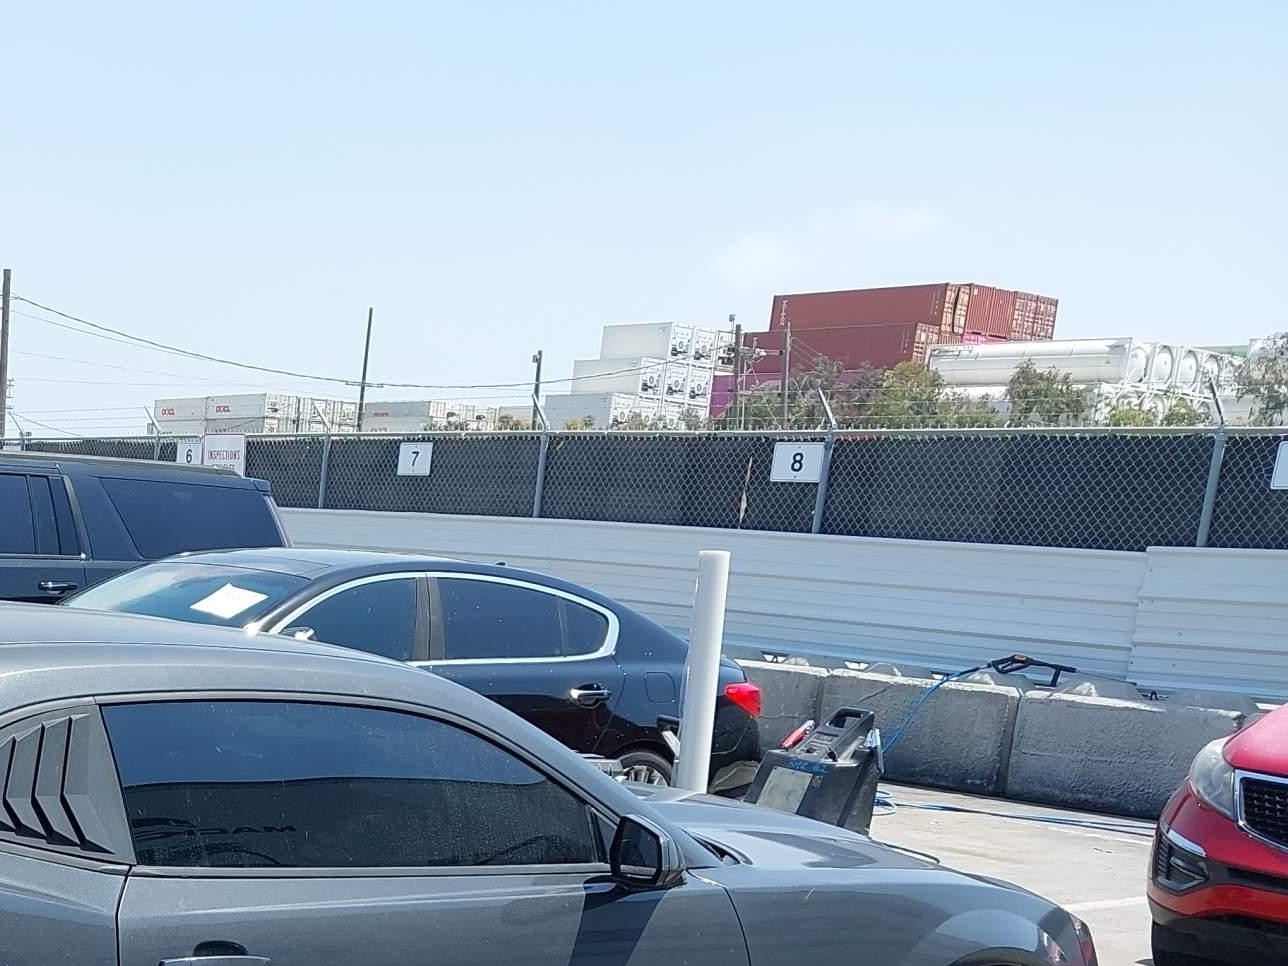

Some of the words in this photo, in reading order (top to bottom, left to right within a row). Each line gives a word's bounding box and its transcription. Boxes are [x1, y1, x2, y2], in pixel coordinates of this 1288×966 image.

[185, 449, 193, 464] 6
[207, 449, 241, 461] INSPECTIONS
[411, 451, 420, 467] 7
[790, 452, 804, 472] 8
